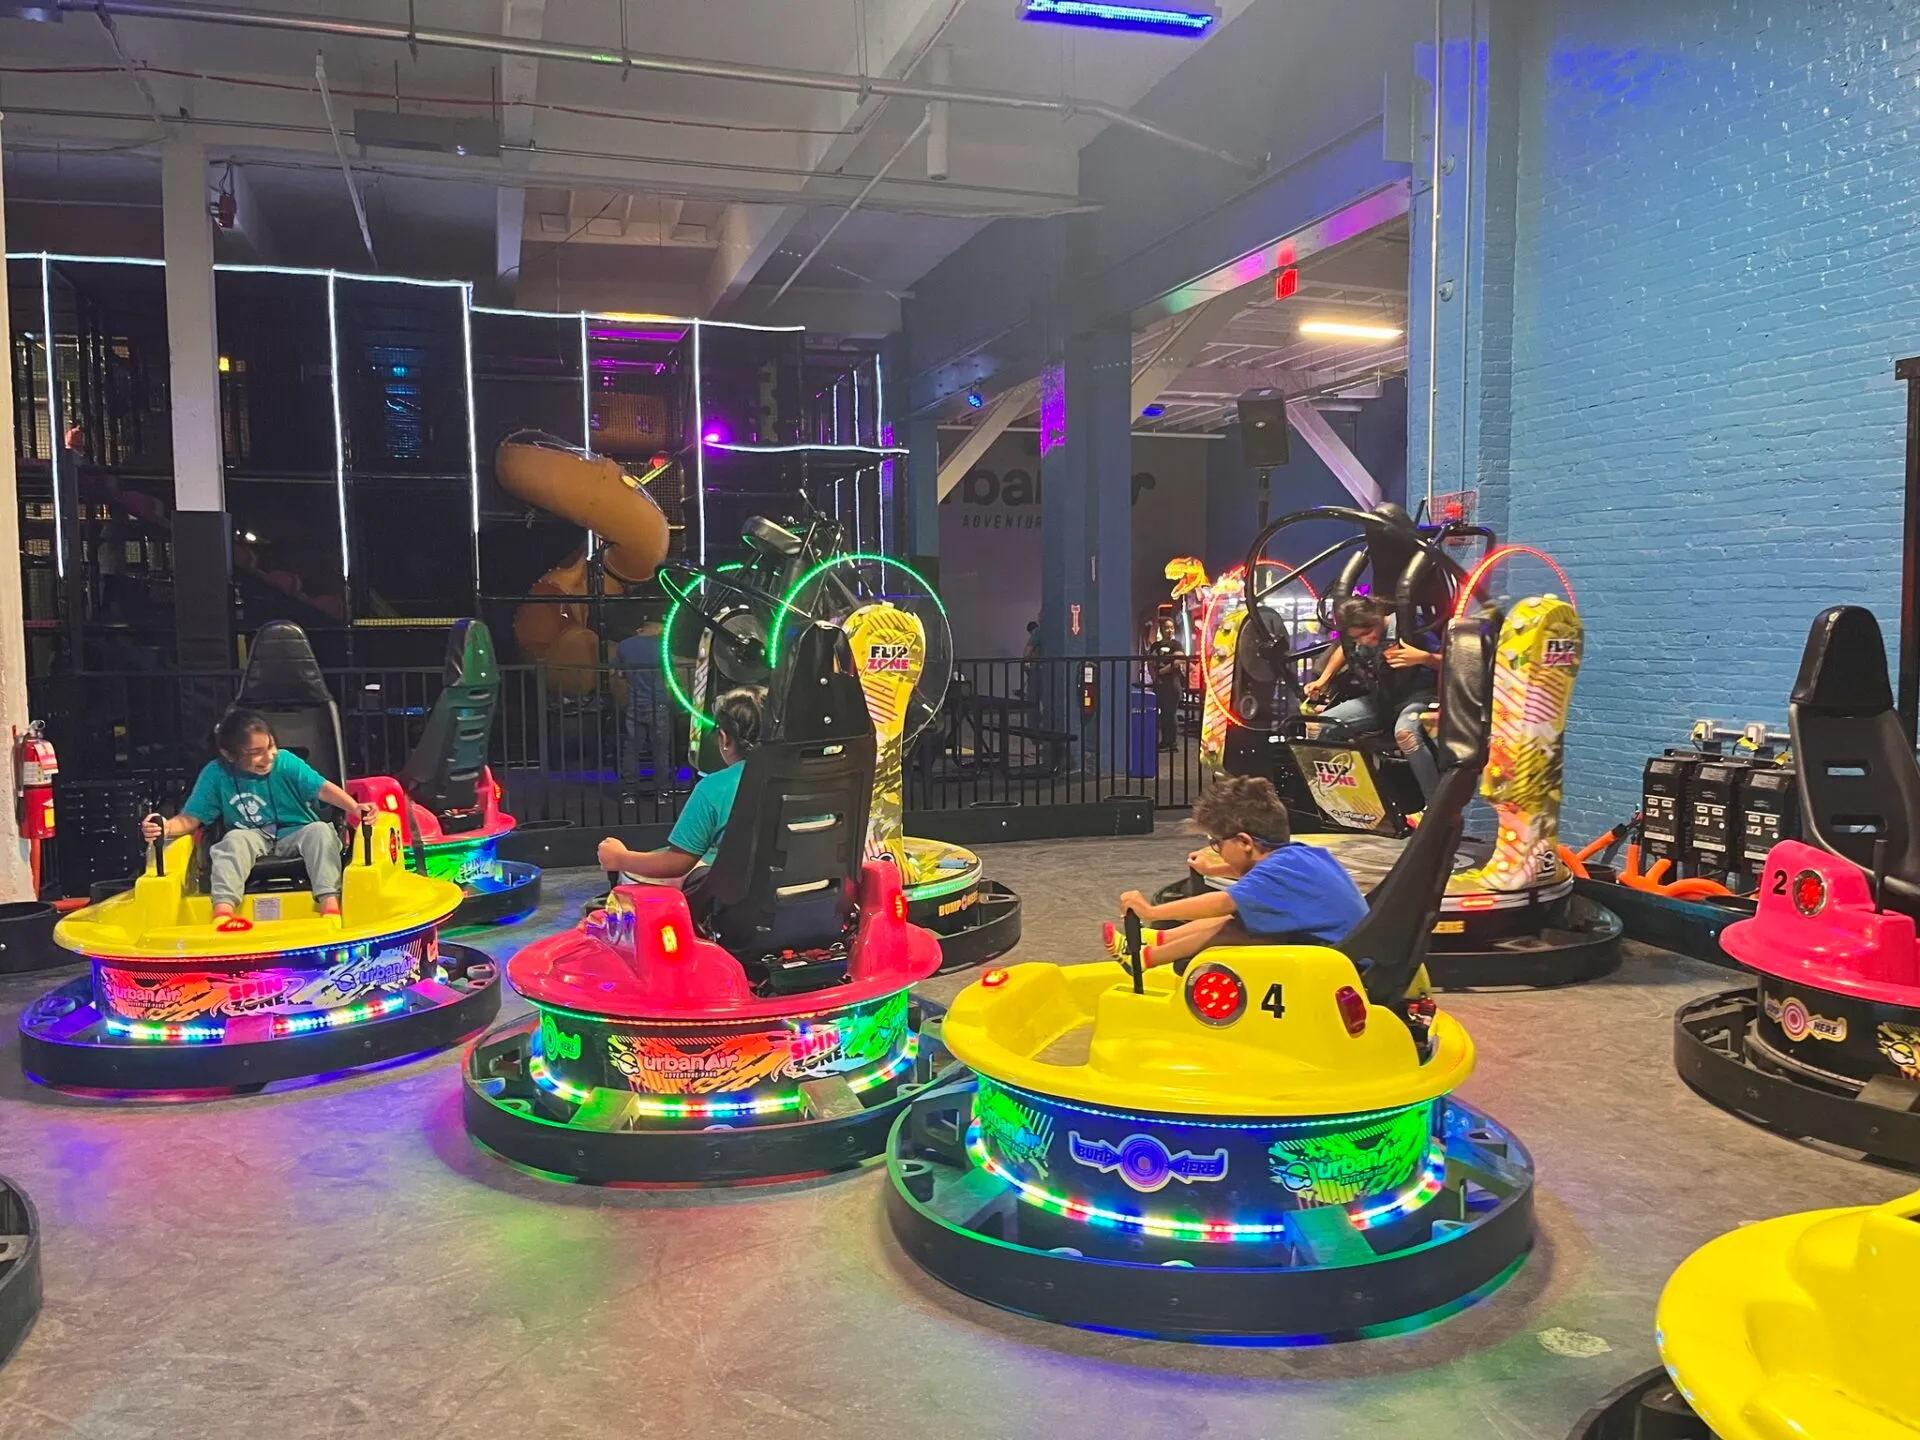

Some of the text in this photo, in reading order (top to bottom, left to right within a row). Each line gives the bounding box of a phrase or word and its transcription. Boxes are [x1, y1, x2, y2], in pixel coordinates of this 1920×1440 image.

[962, 514, 1042, 529] ADVENTUR
[871, 646, 908, 658] FLIP
[868, 659, 909, 670] ZONE
[1773, 870, 1787, 895] 2
[939, 899, 961, 917] BUMP
[229, 977, 285, 1000] SPIN
[1261, 983, 1285, 1019] 4
[1813, 1021, 1838, 1035] HERE
[790, 1030, 841, 1060] SPIN
[1079, 1146, 1215, 1174] BUMP HERE
